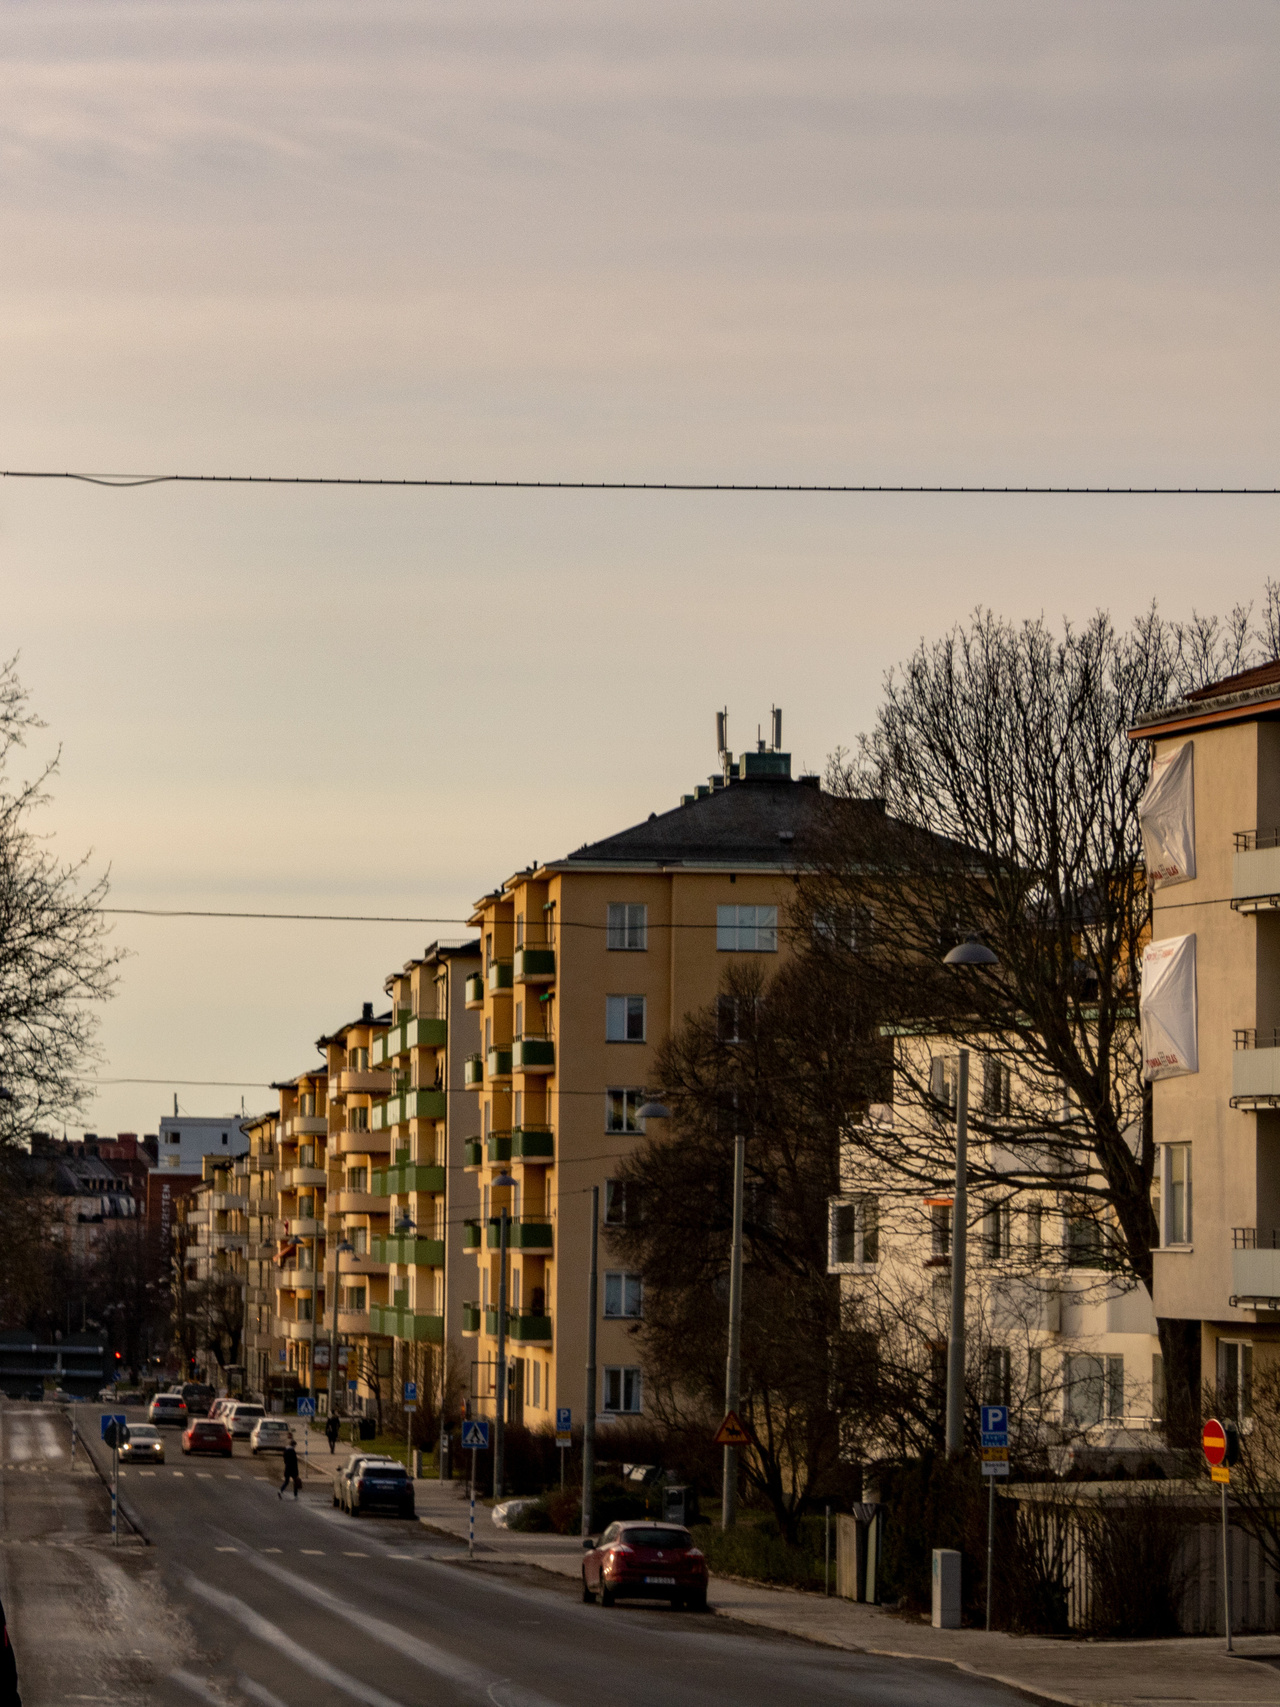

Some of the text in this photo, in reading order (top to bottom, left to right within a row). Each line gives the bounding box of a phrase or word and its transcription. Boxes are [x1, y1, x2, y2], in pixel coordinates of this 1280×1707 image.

[1166, 1054, 1178, 1064] GLAS
[560, 1409, 569, 1422] P
[988, 1408, 1003, 1431] P
